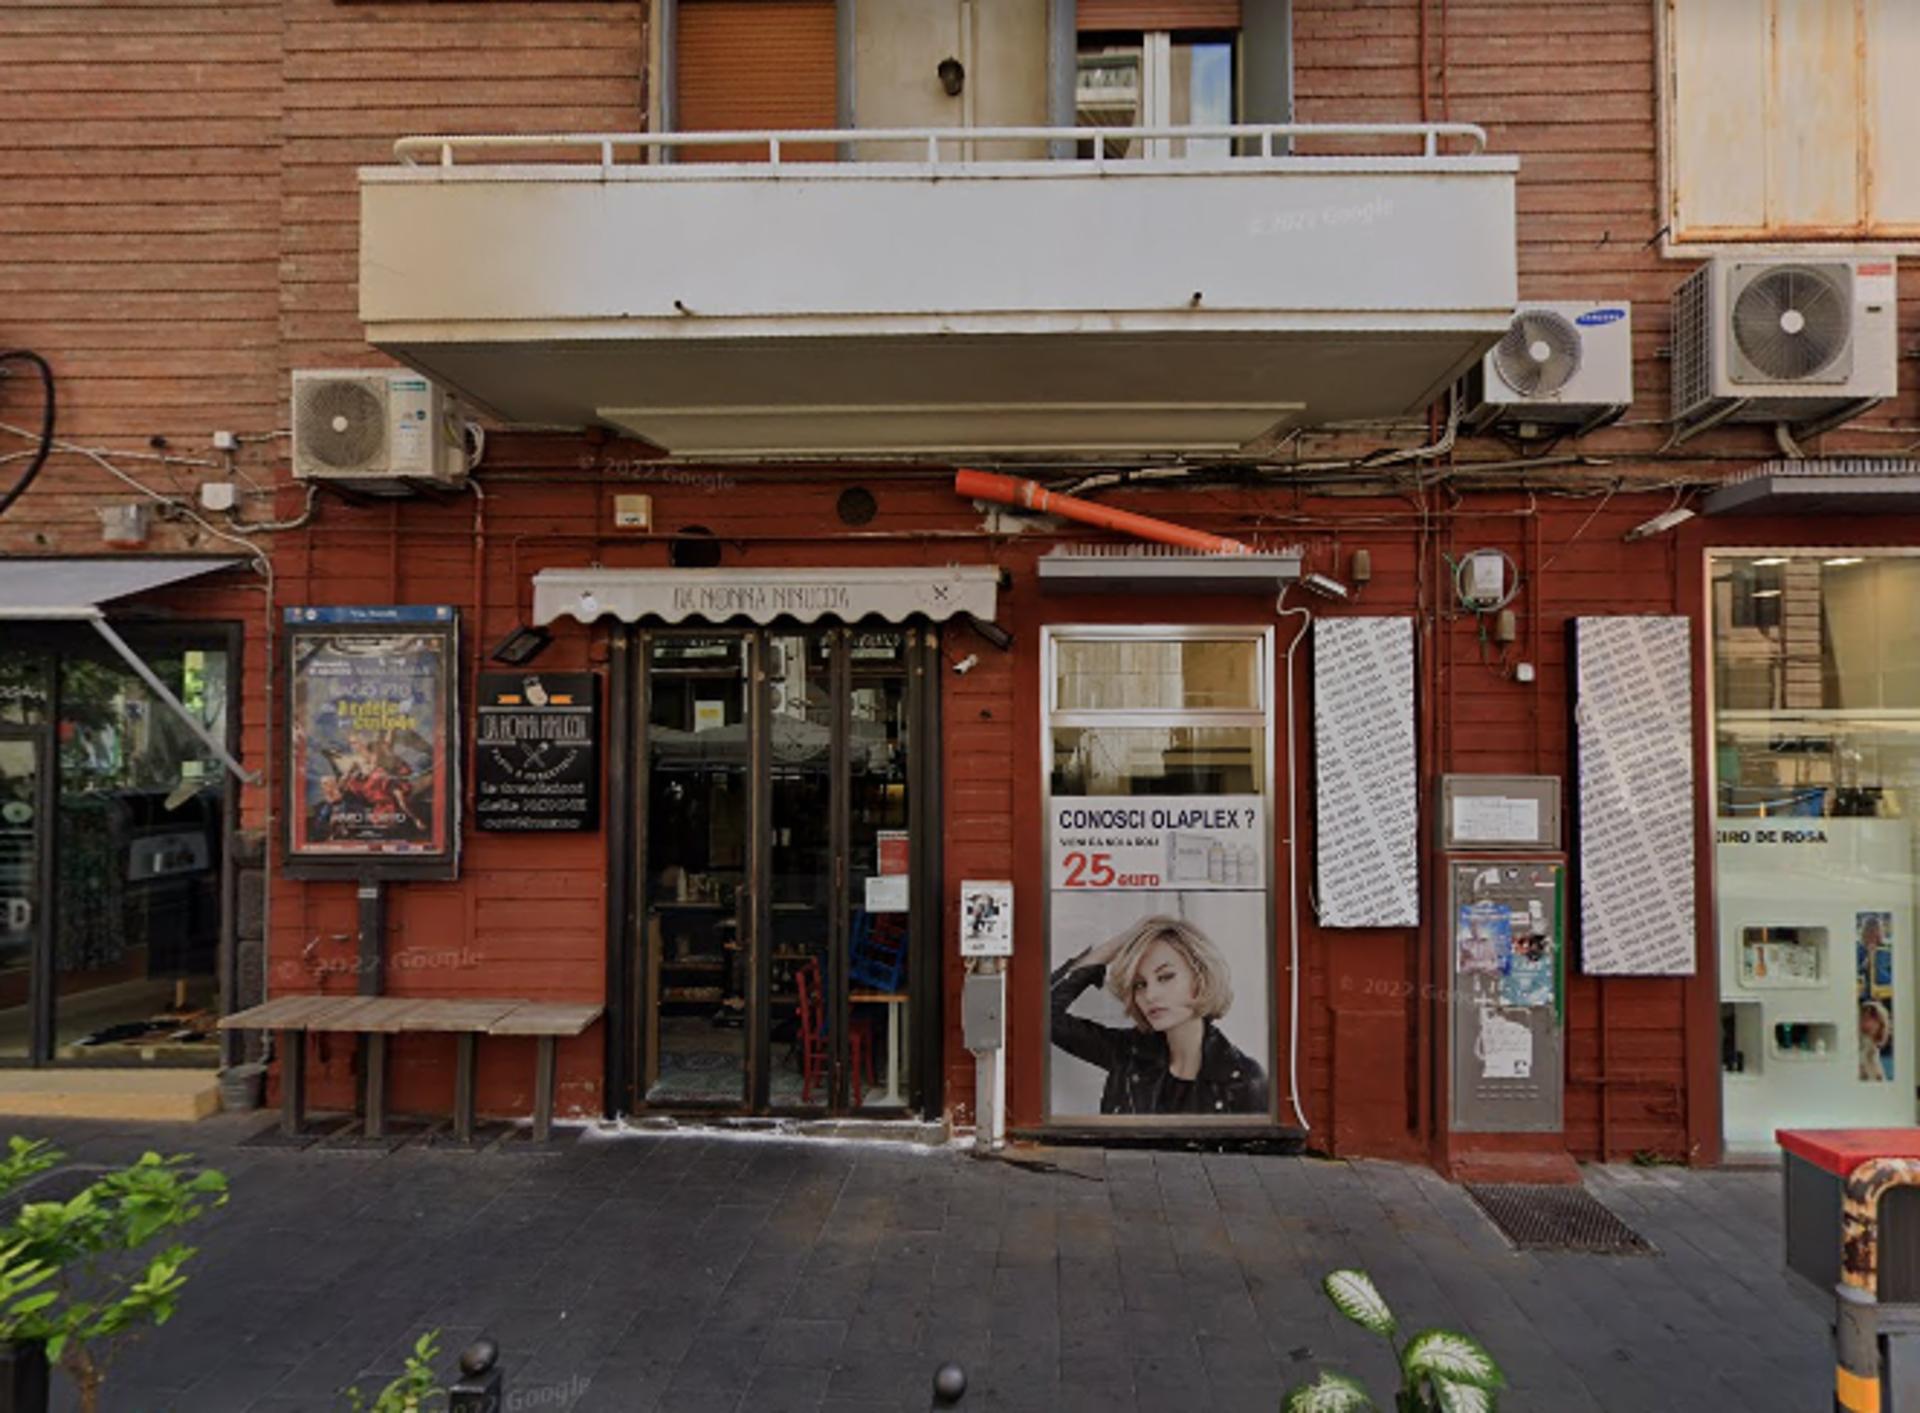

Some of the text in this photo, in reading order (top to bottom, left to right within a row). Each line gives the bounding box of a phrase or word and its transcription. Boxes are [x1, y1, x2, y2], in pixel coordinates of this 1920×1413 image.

[1059, 808, 1256, 829] CONOSCI OLAPLEX ?
[1756, 830, 1778, 844] DE
[1781, 830, 1829, 844] ROSA
[1063, 852, 1161, 887] 25 euro
